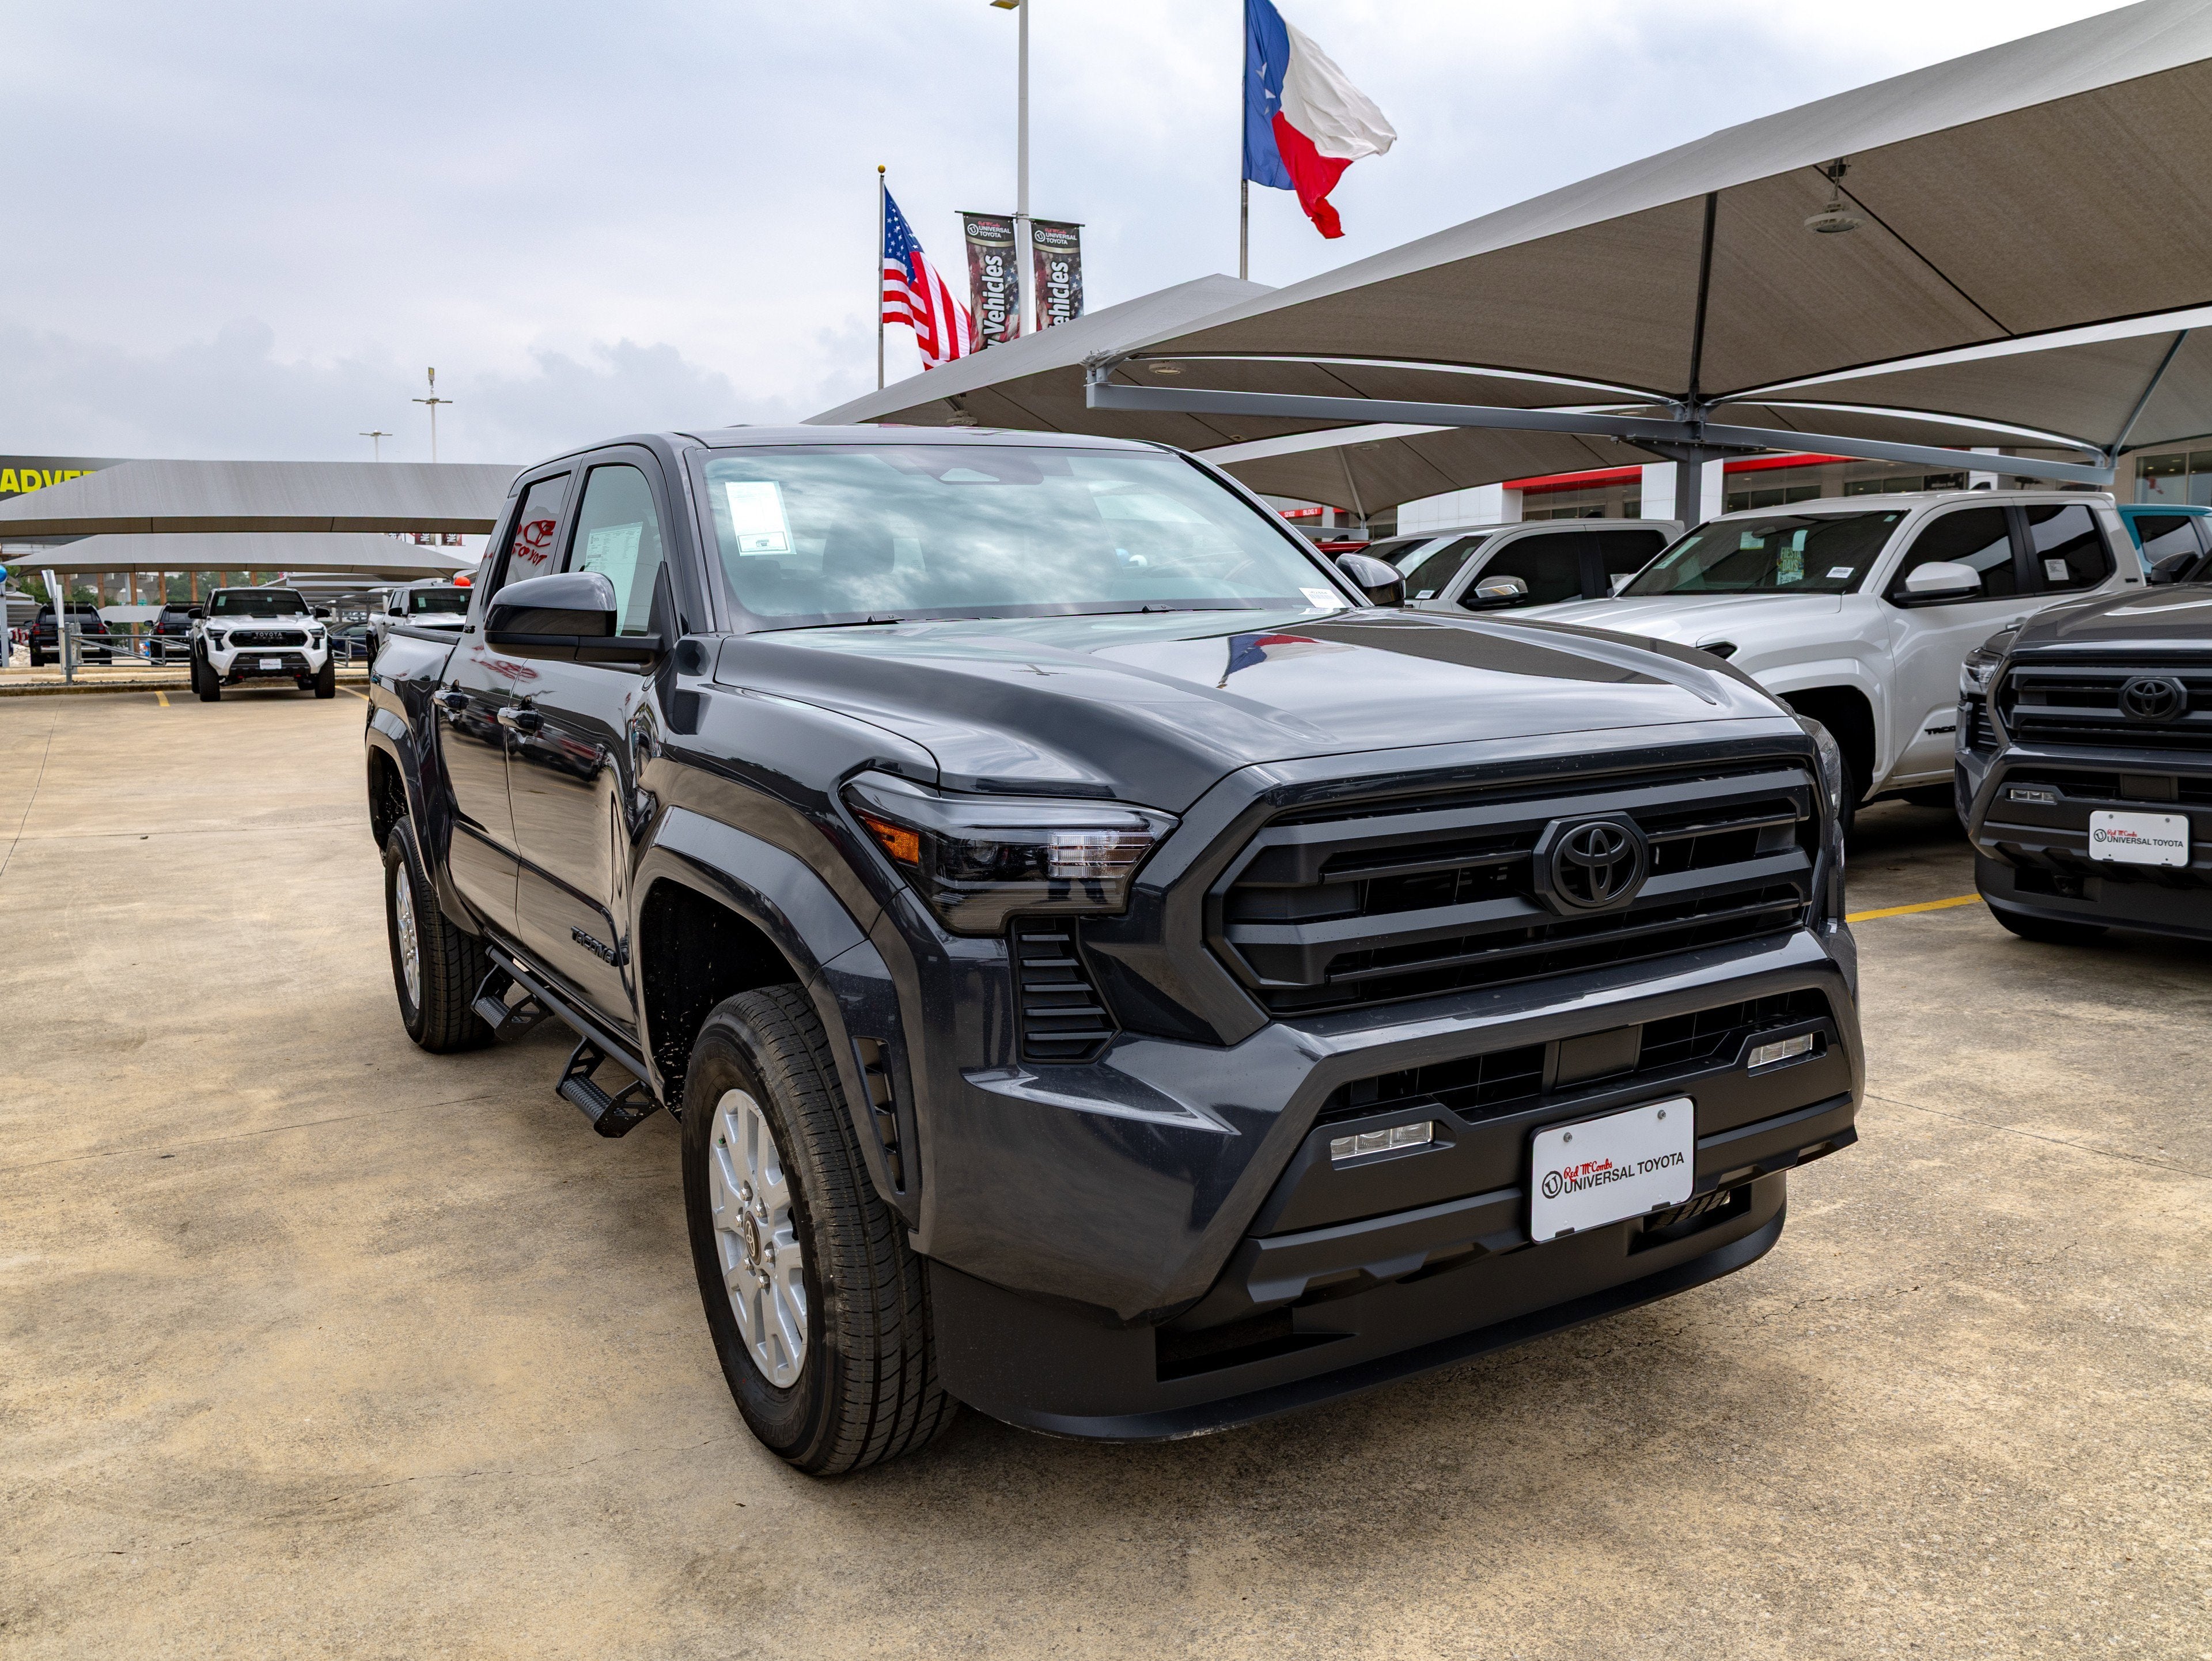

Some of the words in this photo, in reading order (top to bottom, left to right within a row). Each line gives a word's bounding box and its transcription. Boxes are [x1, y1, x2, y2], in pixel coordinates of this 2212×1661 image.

[979, 225, 1012, 233] UNIVERSAL
[1046, 232, 1077, 240] UNIVERSAL
[981, 254, 1005, 335] Vehicles
[1047, 261, 1070, 328] ehicles
[420, 533, 430, 542] Ne
[446, 534, 456, 542] Ne
[1783, 559, 1798, 572] DAYS
[2107, 837, 2152, 846] UNIVERSAL
[2153, 839, 2183, 847] TOYOTA
[1563, 1165, 1579, 1182] Red
[1580, 1158, 1612, 1175] McCombs
[1564, 1165, 1635, 1194] UNIVERSAL
[1637, 1152, 1684, 1174] TOYOTA
